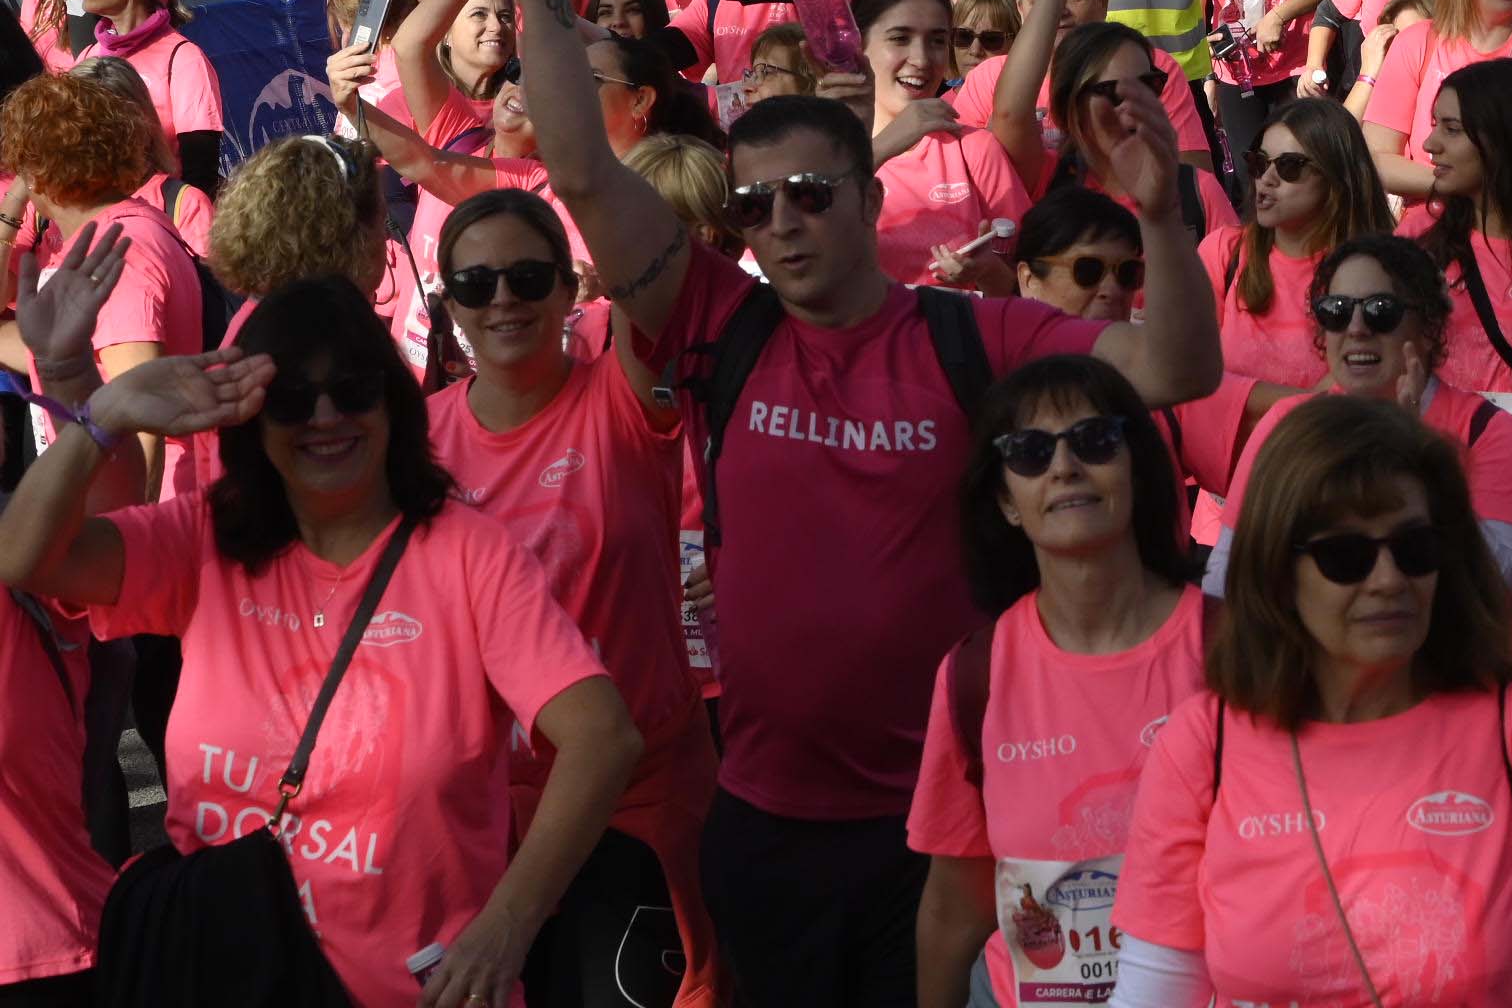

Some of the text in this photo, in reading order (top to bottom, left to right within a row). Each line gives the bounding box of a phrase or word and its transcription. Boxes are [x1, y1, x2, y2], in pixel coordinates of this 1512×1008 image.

[749, 399, 937, 451] RELLINARS
[238, 598, 300, 632] OYSHO
[996, 733, 1078, 764] OYSHO
[197, 743, 259, 793] TU
[1237, 808, 1327, 840] OYSHO
[1414, 805, 1487, 825] ASTURIANA
[1035, 986, 1083, 999] CARRERA
